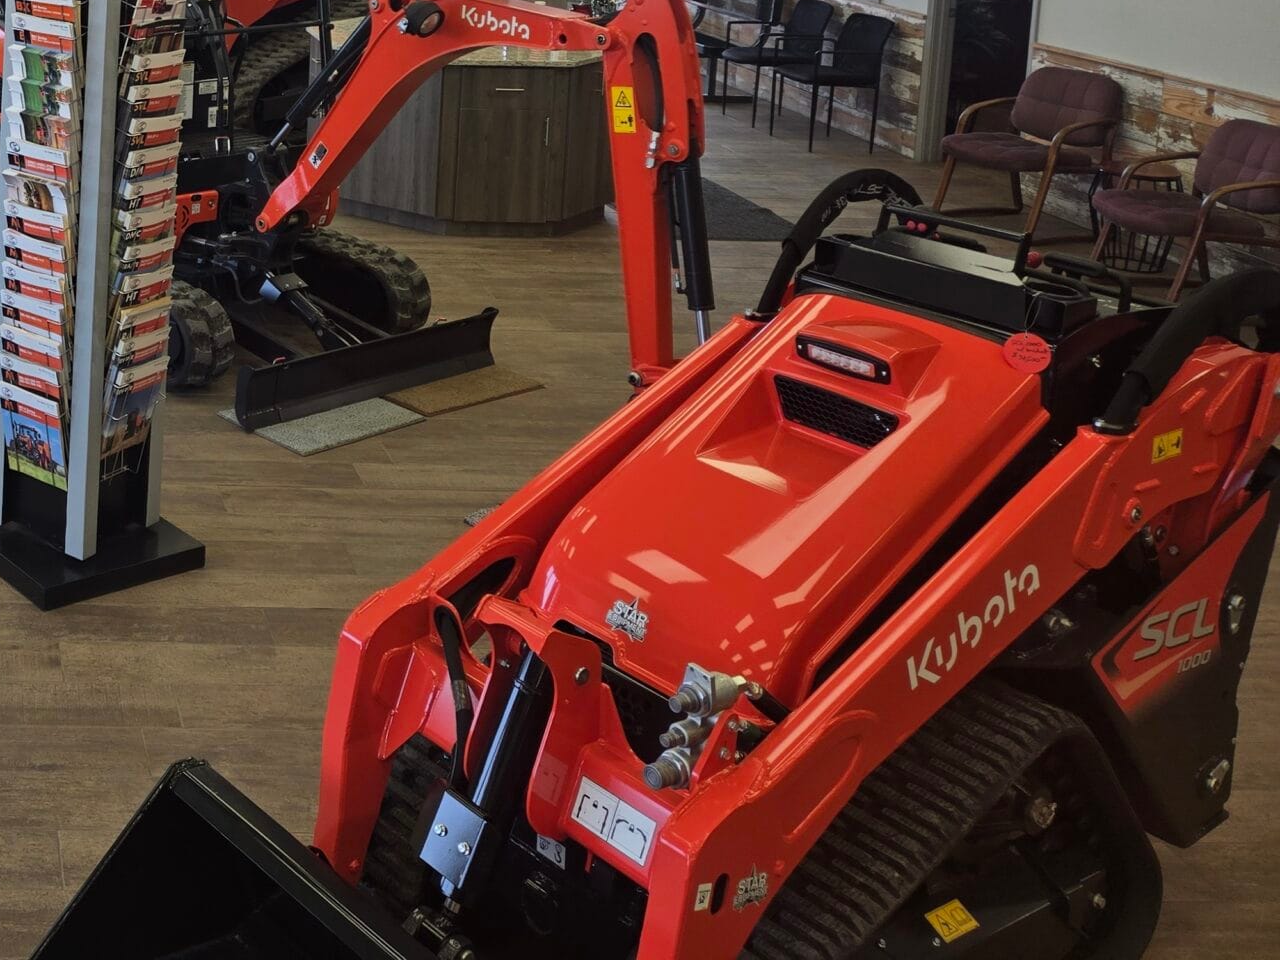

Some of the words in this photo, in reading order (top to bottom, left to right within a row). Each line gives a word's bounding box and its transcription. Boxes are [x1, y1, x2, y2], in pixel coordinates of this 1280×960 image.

[461, 4, 530, 40] Kubota
[614, 601, 648, 628] STAR
[906, 563, 1041, 691] Kubota
[1133, 597, 1217, 662] SCL
[1177, 649, 1212, 674] 1000
[738, 872, 767, 895] STAR
